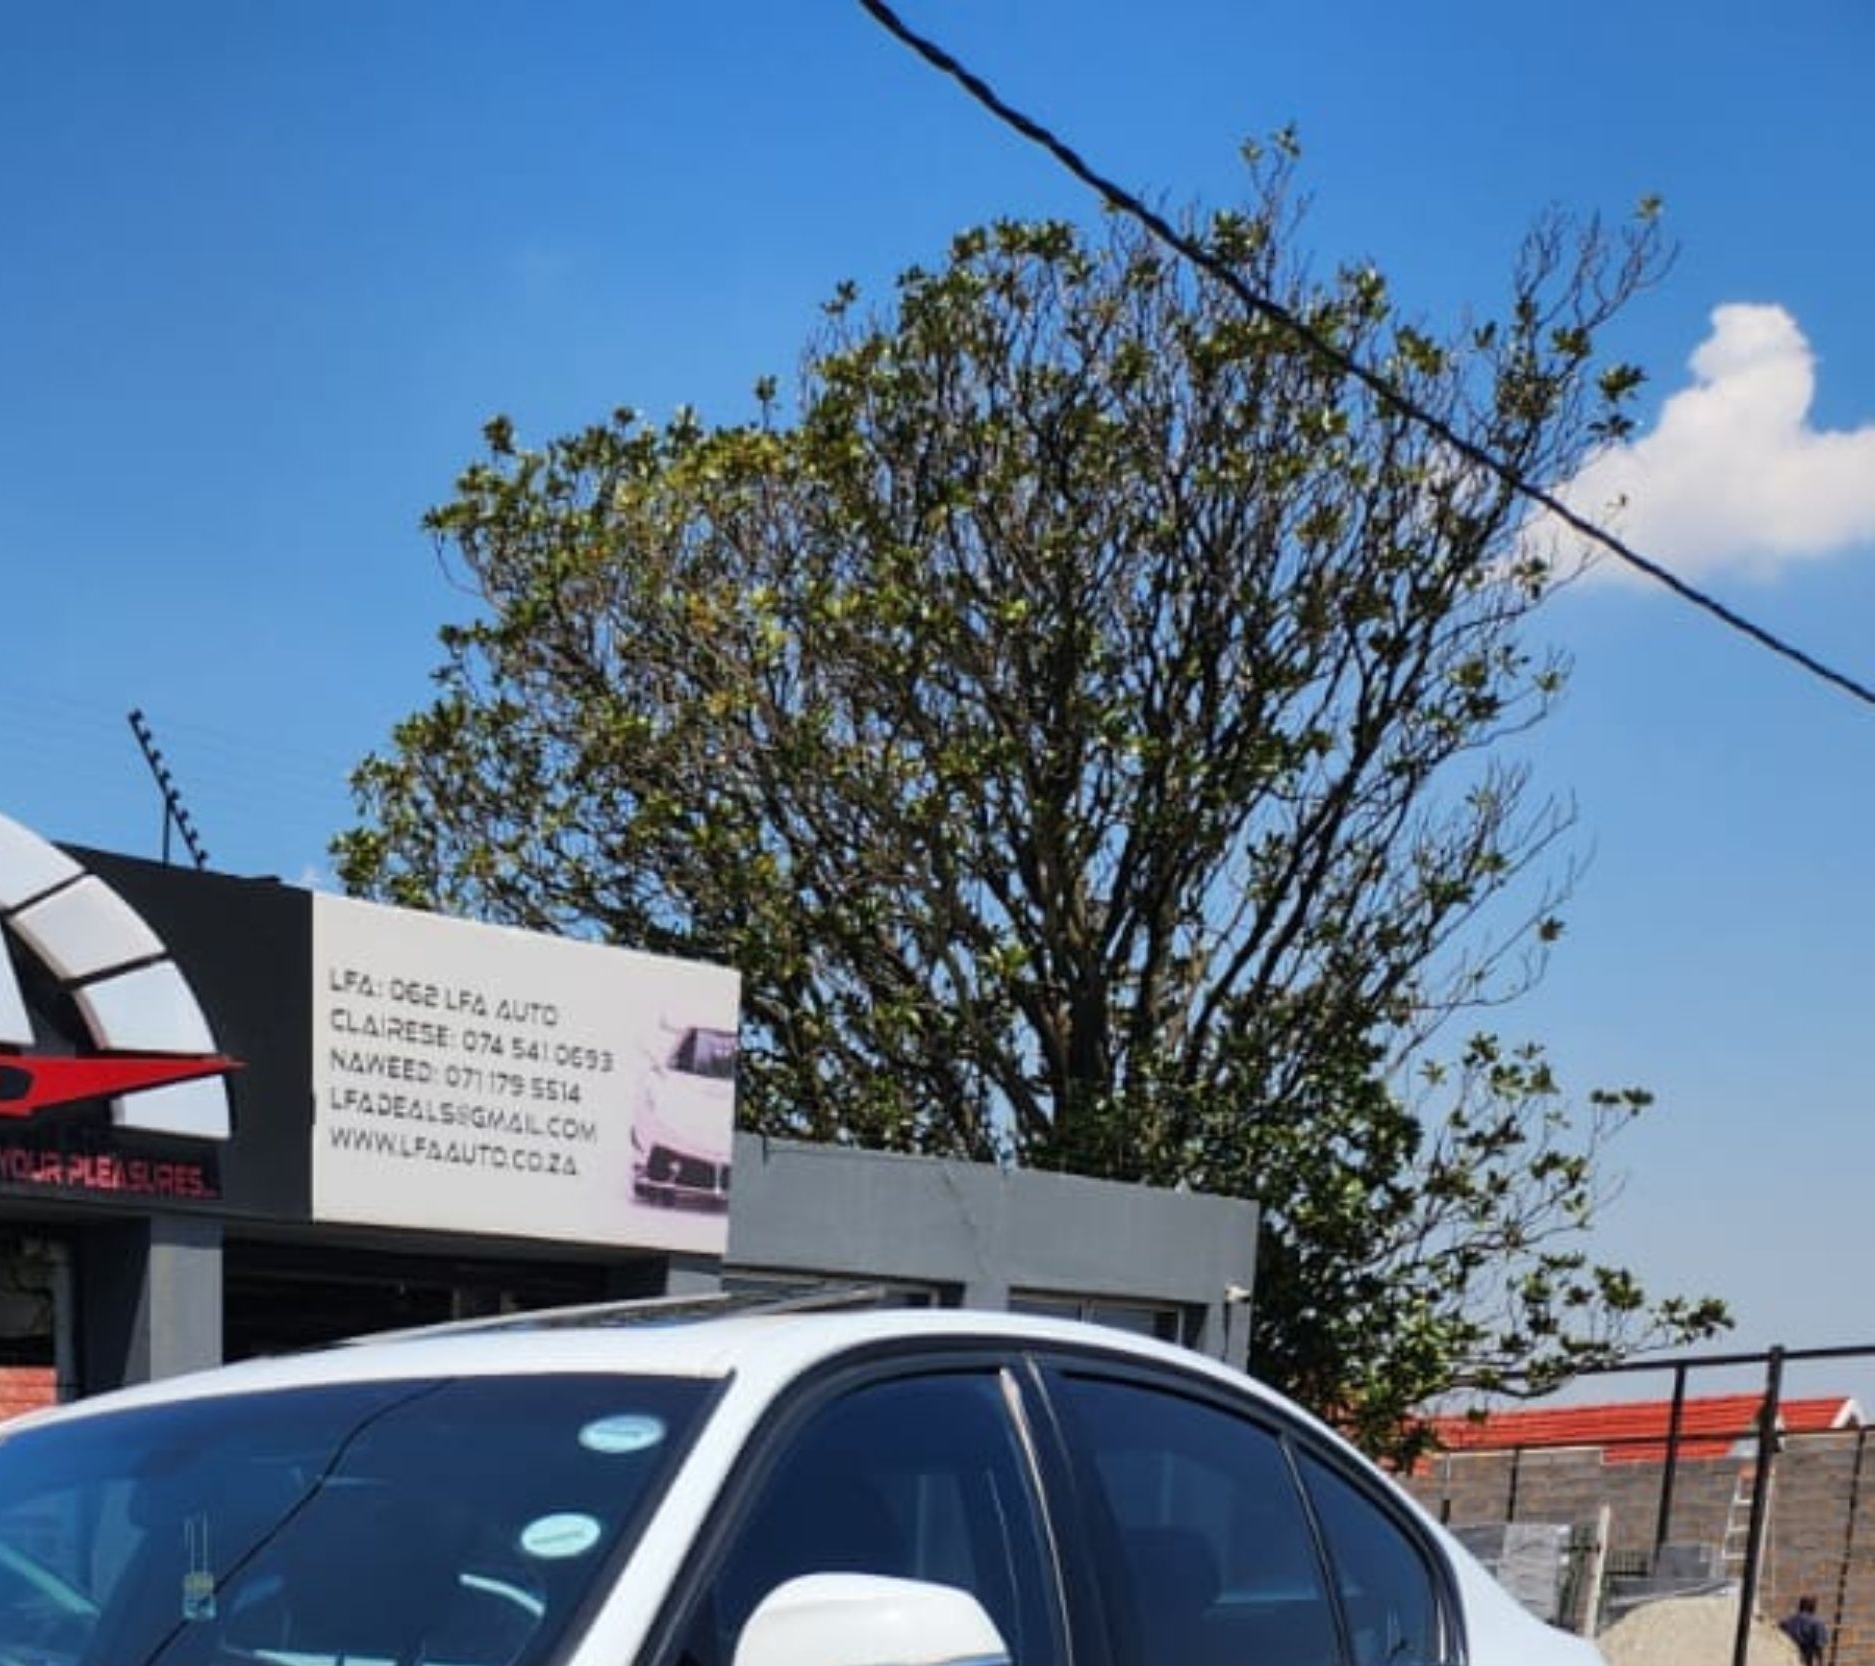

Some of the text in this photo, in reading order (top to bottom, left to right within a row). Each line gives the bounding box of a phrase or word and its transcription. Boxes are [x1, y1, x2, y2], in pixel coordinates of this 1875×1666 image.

[329, 967, 559, 1027] LFA: 062 LFA AUTO
[330, 1007, 456, 1049] CLAIRESE:
[462, 1029, 505, 1056] 074
[511, 1036, 548, 1062] 541
[330, 1047, 582, 1105] NAWEED: 071 179 5514
[329, 1126, 579, 1176] WWW.LFAAUTO.CO.ZA
